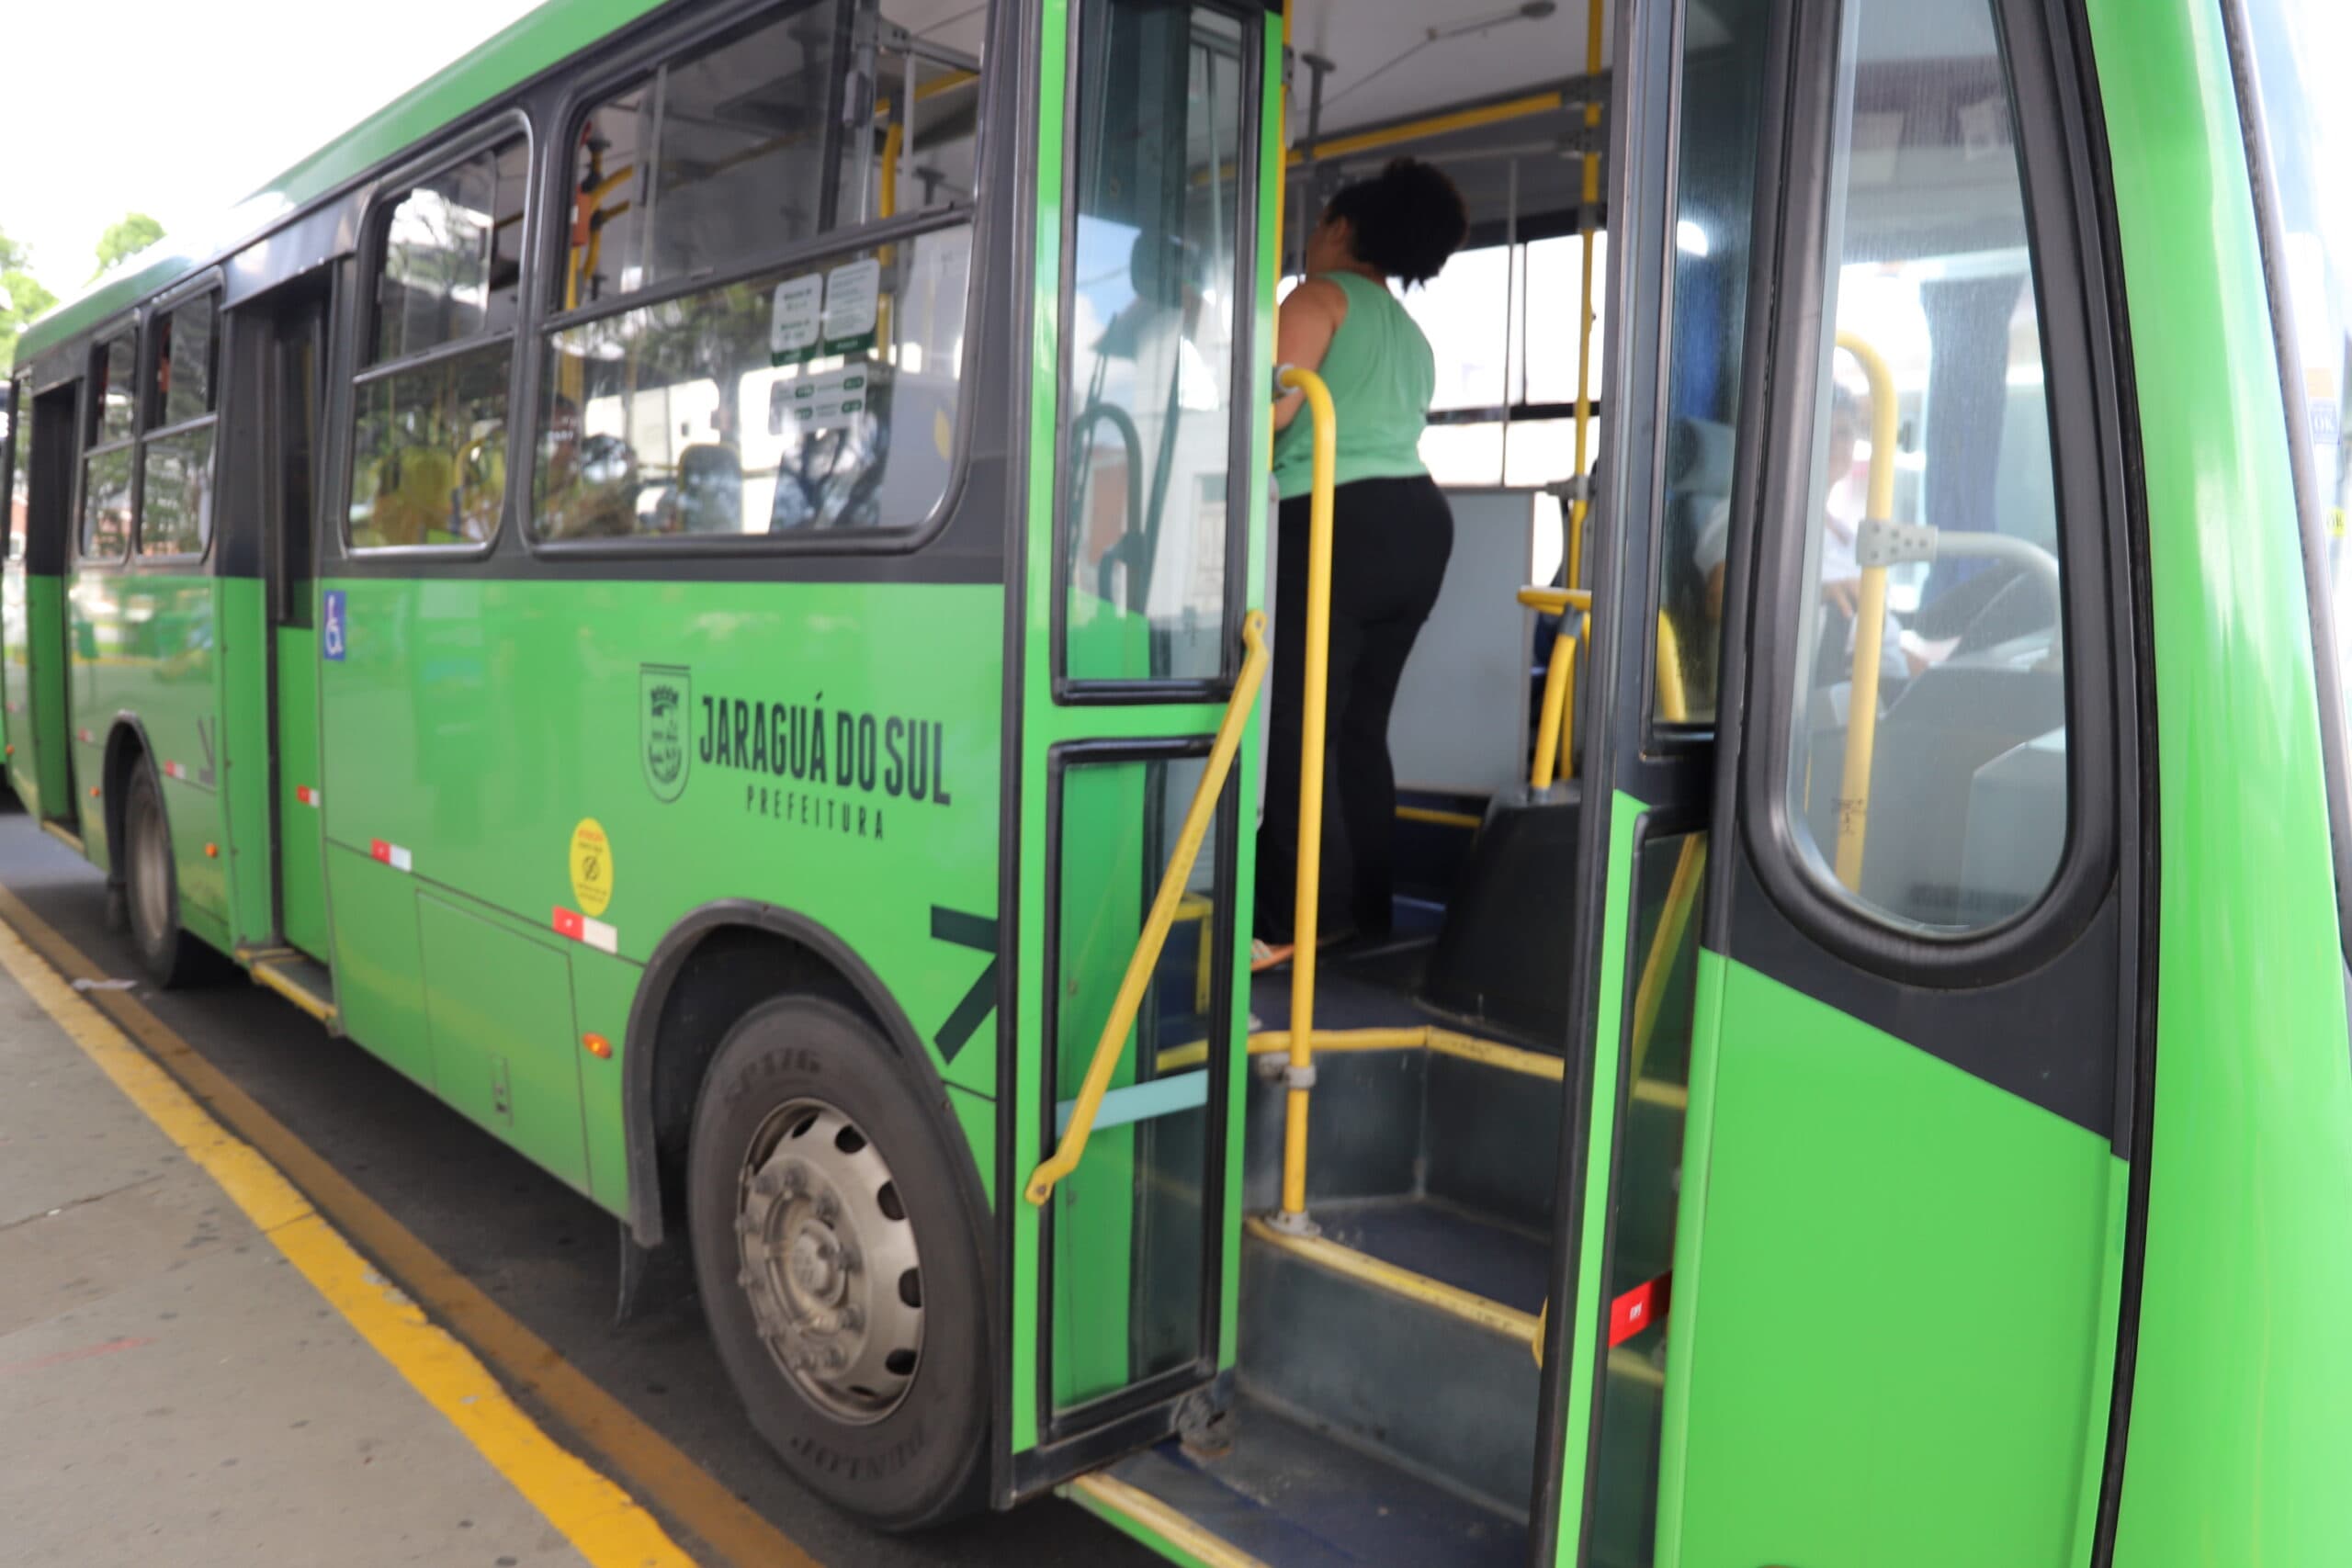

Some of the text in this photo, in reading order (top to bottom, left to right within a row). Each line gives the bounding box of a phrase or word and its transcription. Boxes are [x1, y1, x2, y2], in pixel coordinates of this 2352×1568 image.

[700, 691, 951, 807] JARAGUÁ DO SUL
[746, 784, 883, 840] PREFEITURA
